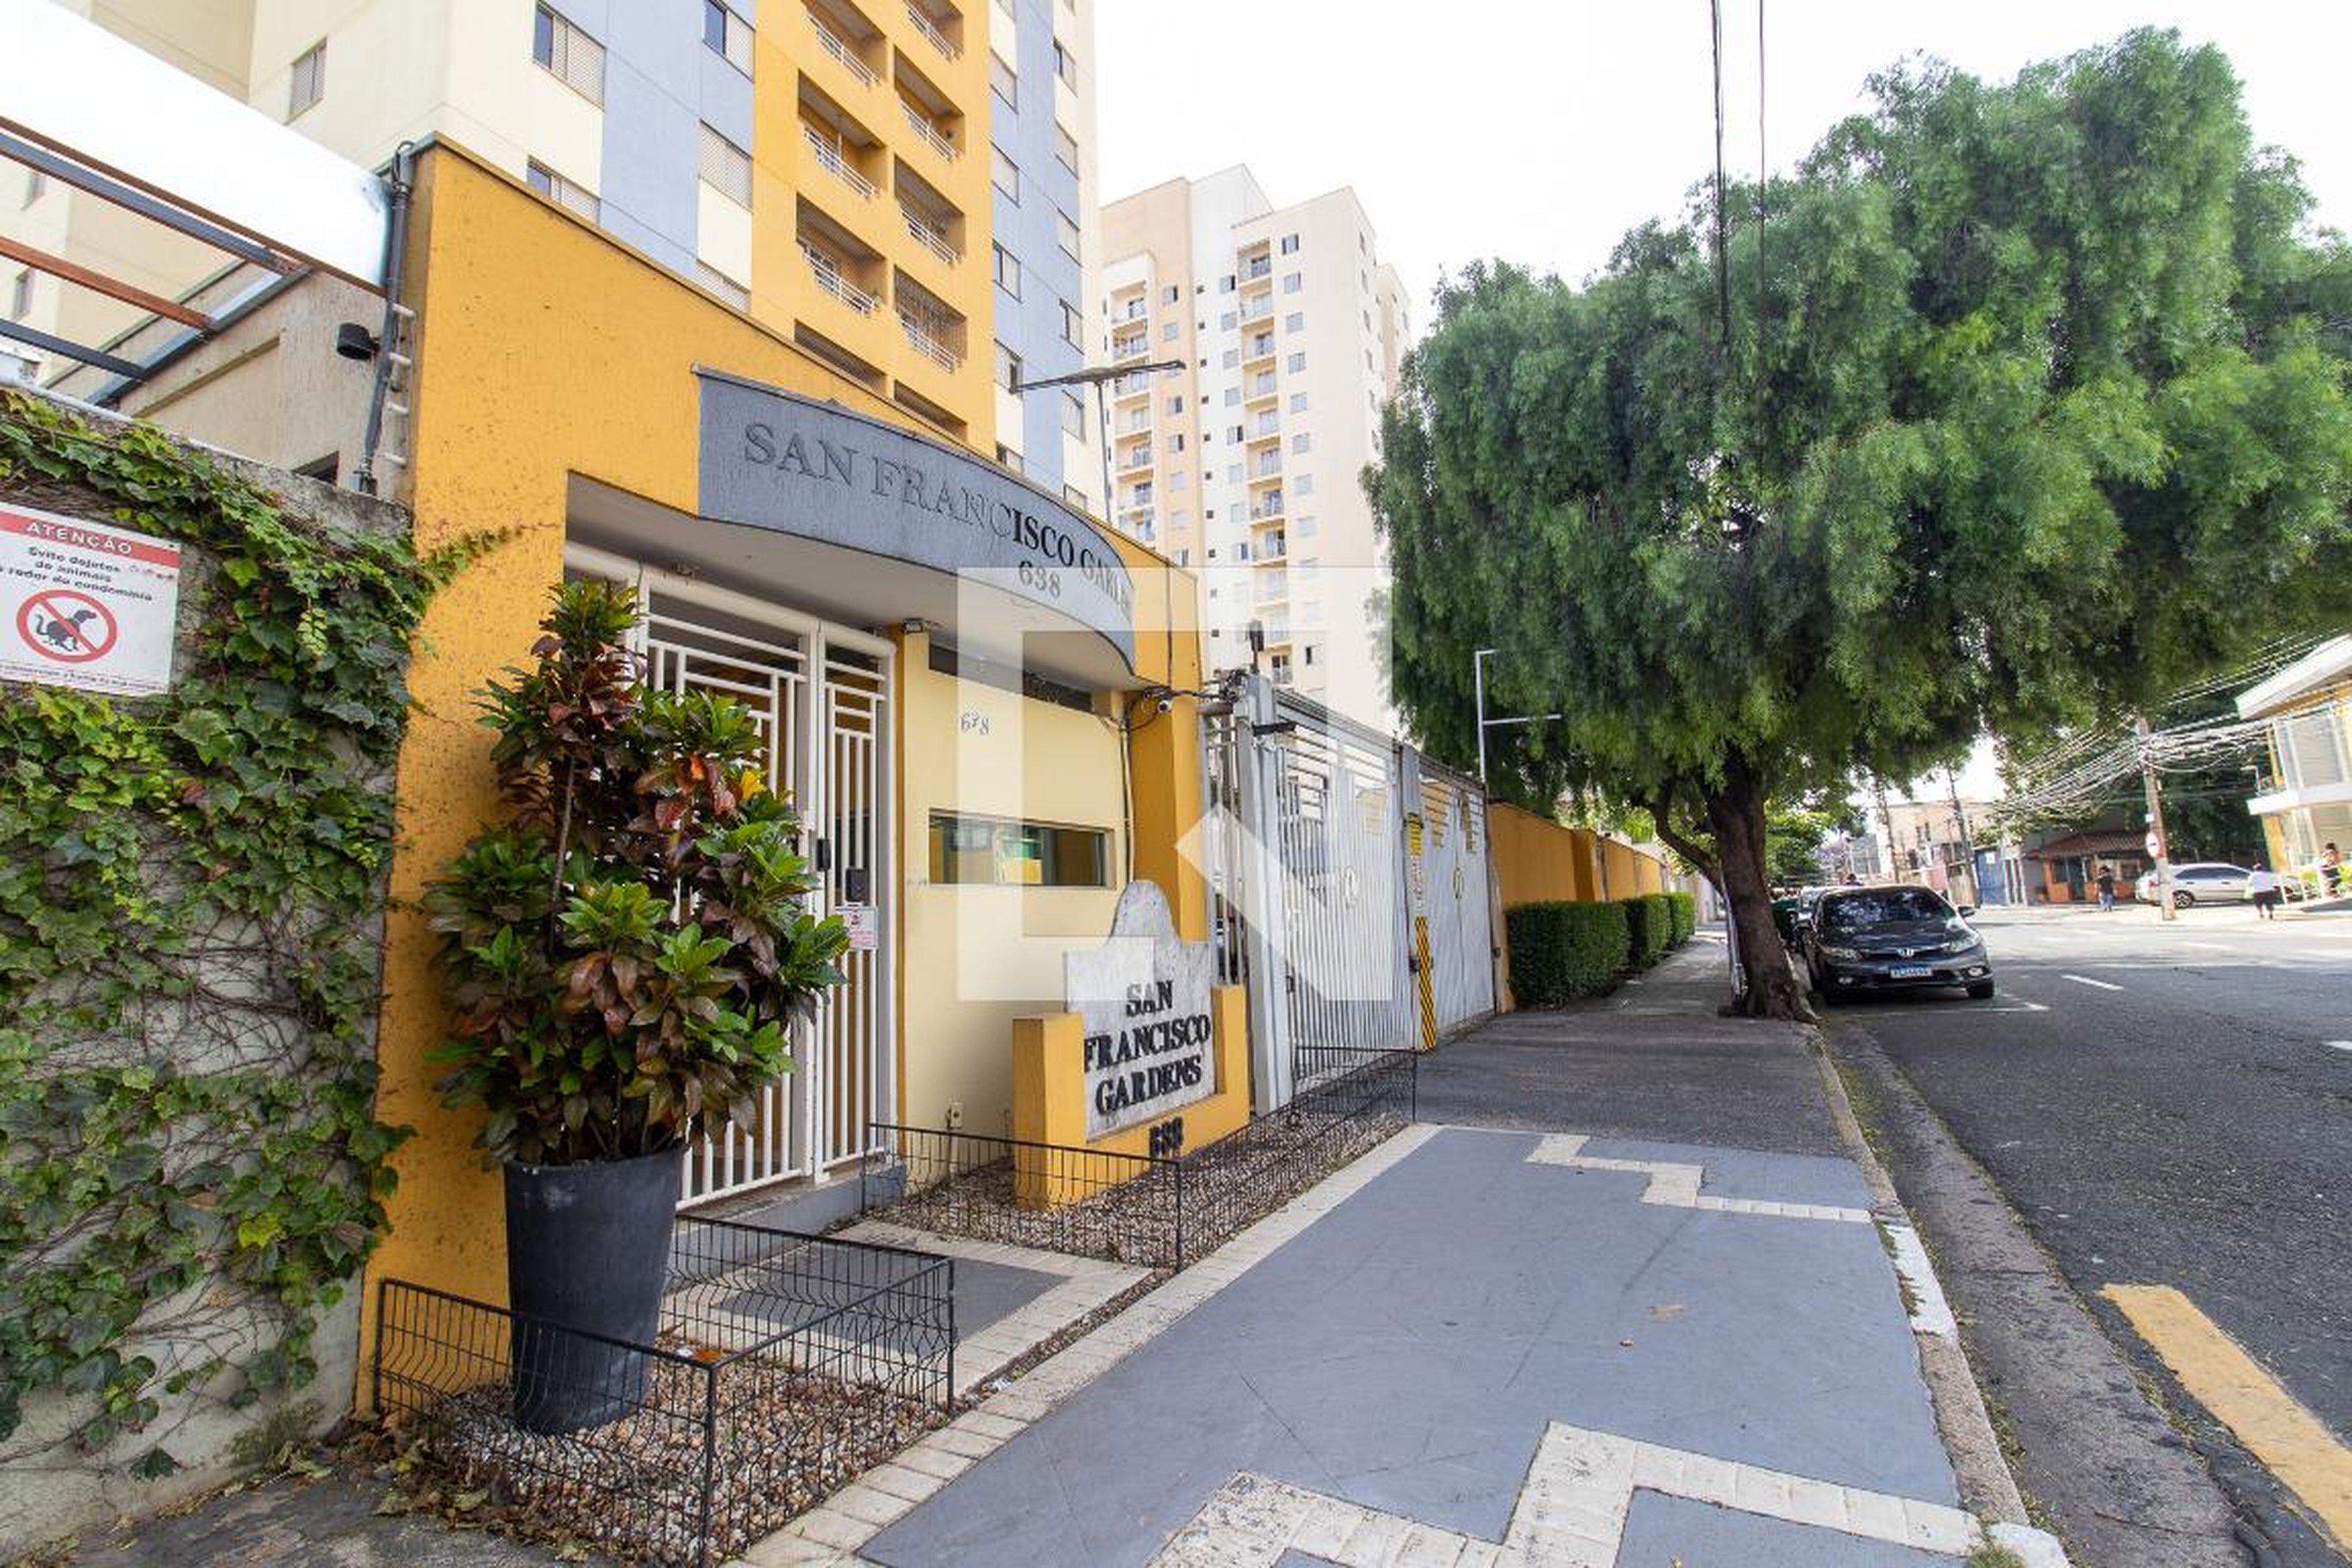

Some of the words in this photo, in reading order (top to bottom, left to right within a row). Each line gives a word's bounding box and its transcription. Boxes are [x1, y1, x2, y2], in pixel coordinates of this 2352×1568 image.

[744, 423, 859, 486] SAN
[871, 456, 1075, 567] FRANCISCO
[1019, 560, 1061, 599] 638
[1126, 979, 1174, 1017] SAN
[1084, 1014, 1211, 1074] FRANCISCO
[1095, 1055, 1201, 1116] GARDENS
